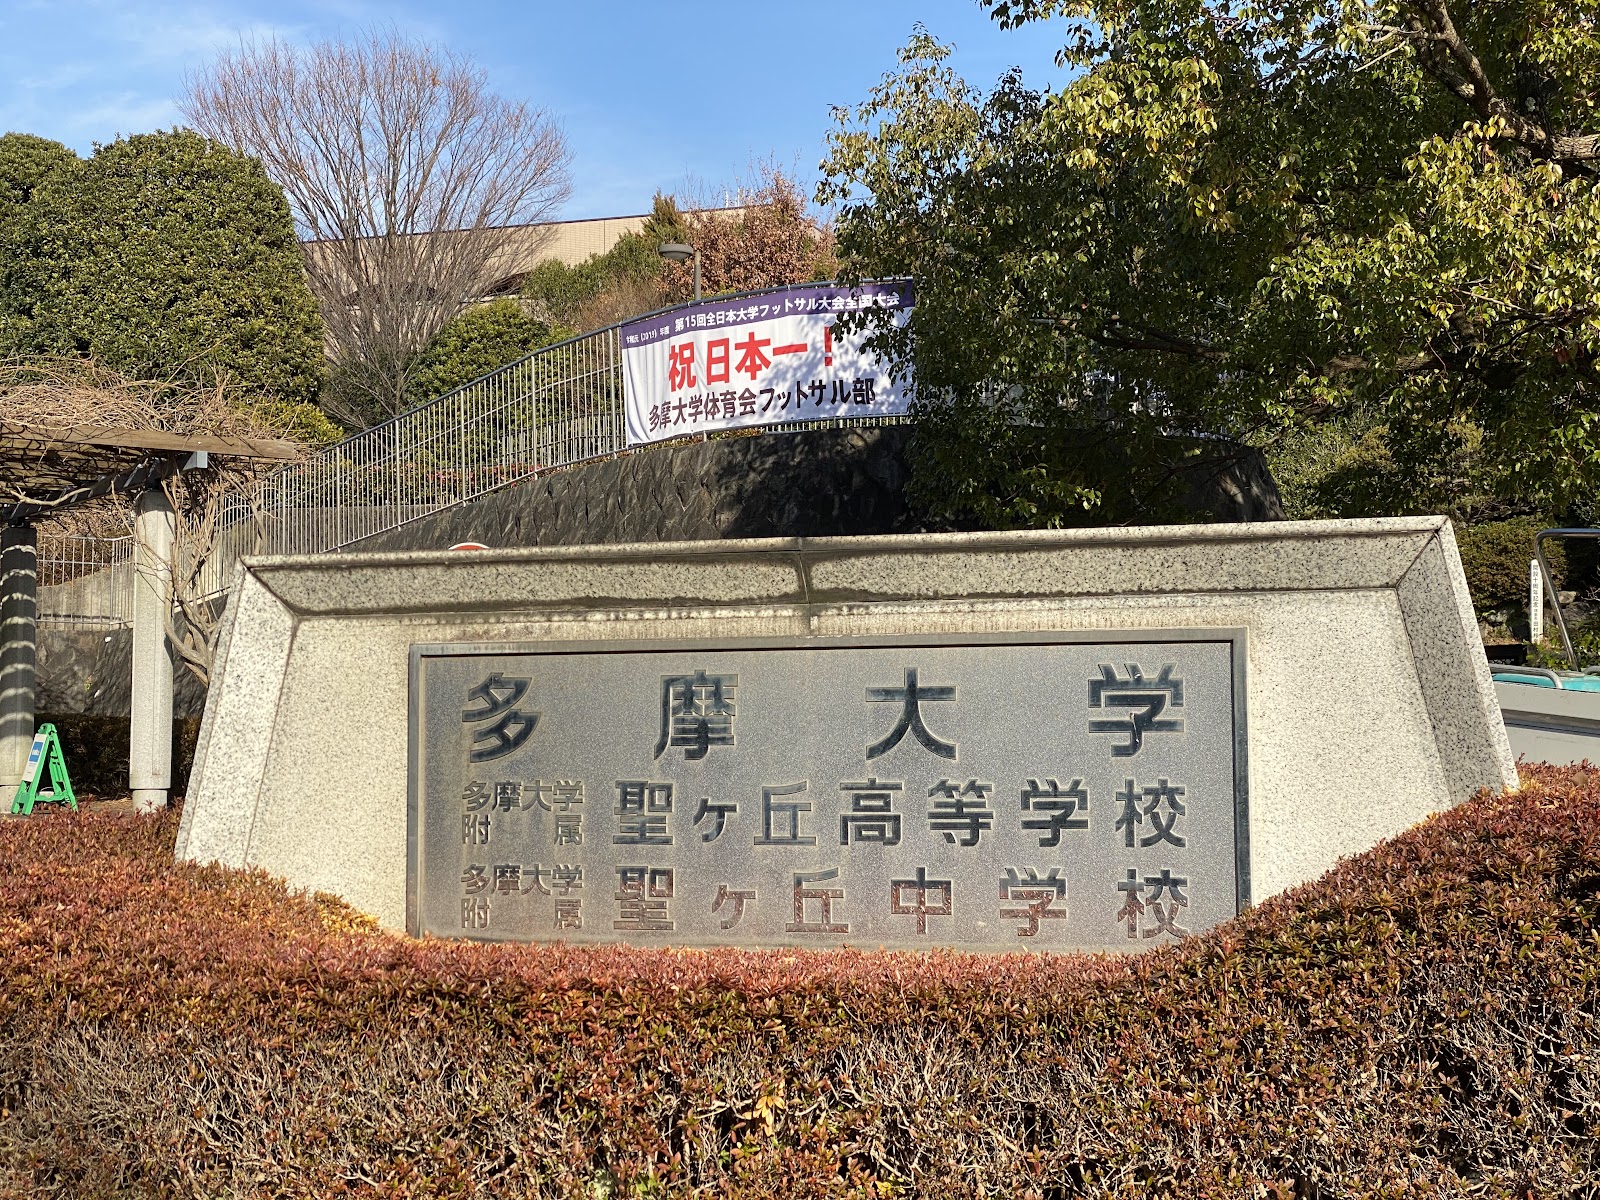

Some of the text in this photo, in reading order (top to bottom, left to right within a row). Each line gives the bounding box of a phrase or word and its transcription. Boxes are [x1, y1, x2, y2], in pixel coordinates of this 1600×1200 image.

[649, 378, 875, 431] 多摩大学体育会フットサル部
[461, 663, 1185, 763] 多摩大学
[462, 780, 584, 812] 多摩大学
[461, 863, 583, 896] 多摩大学
